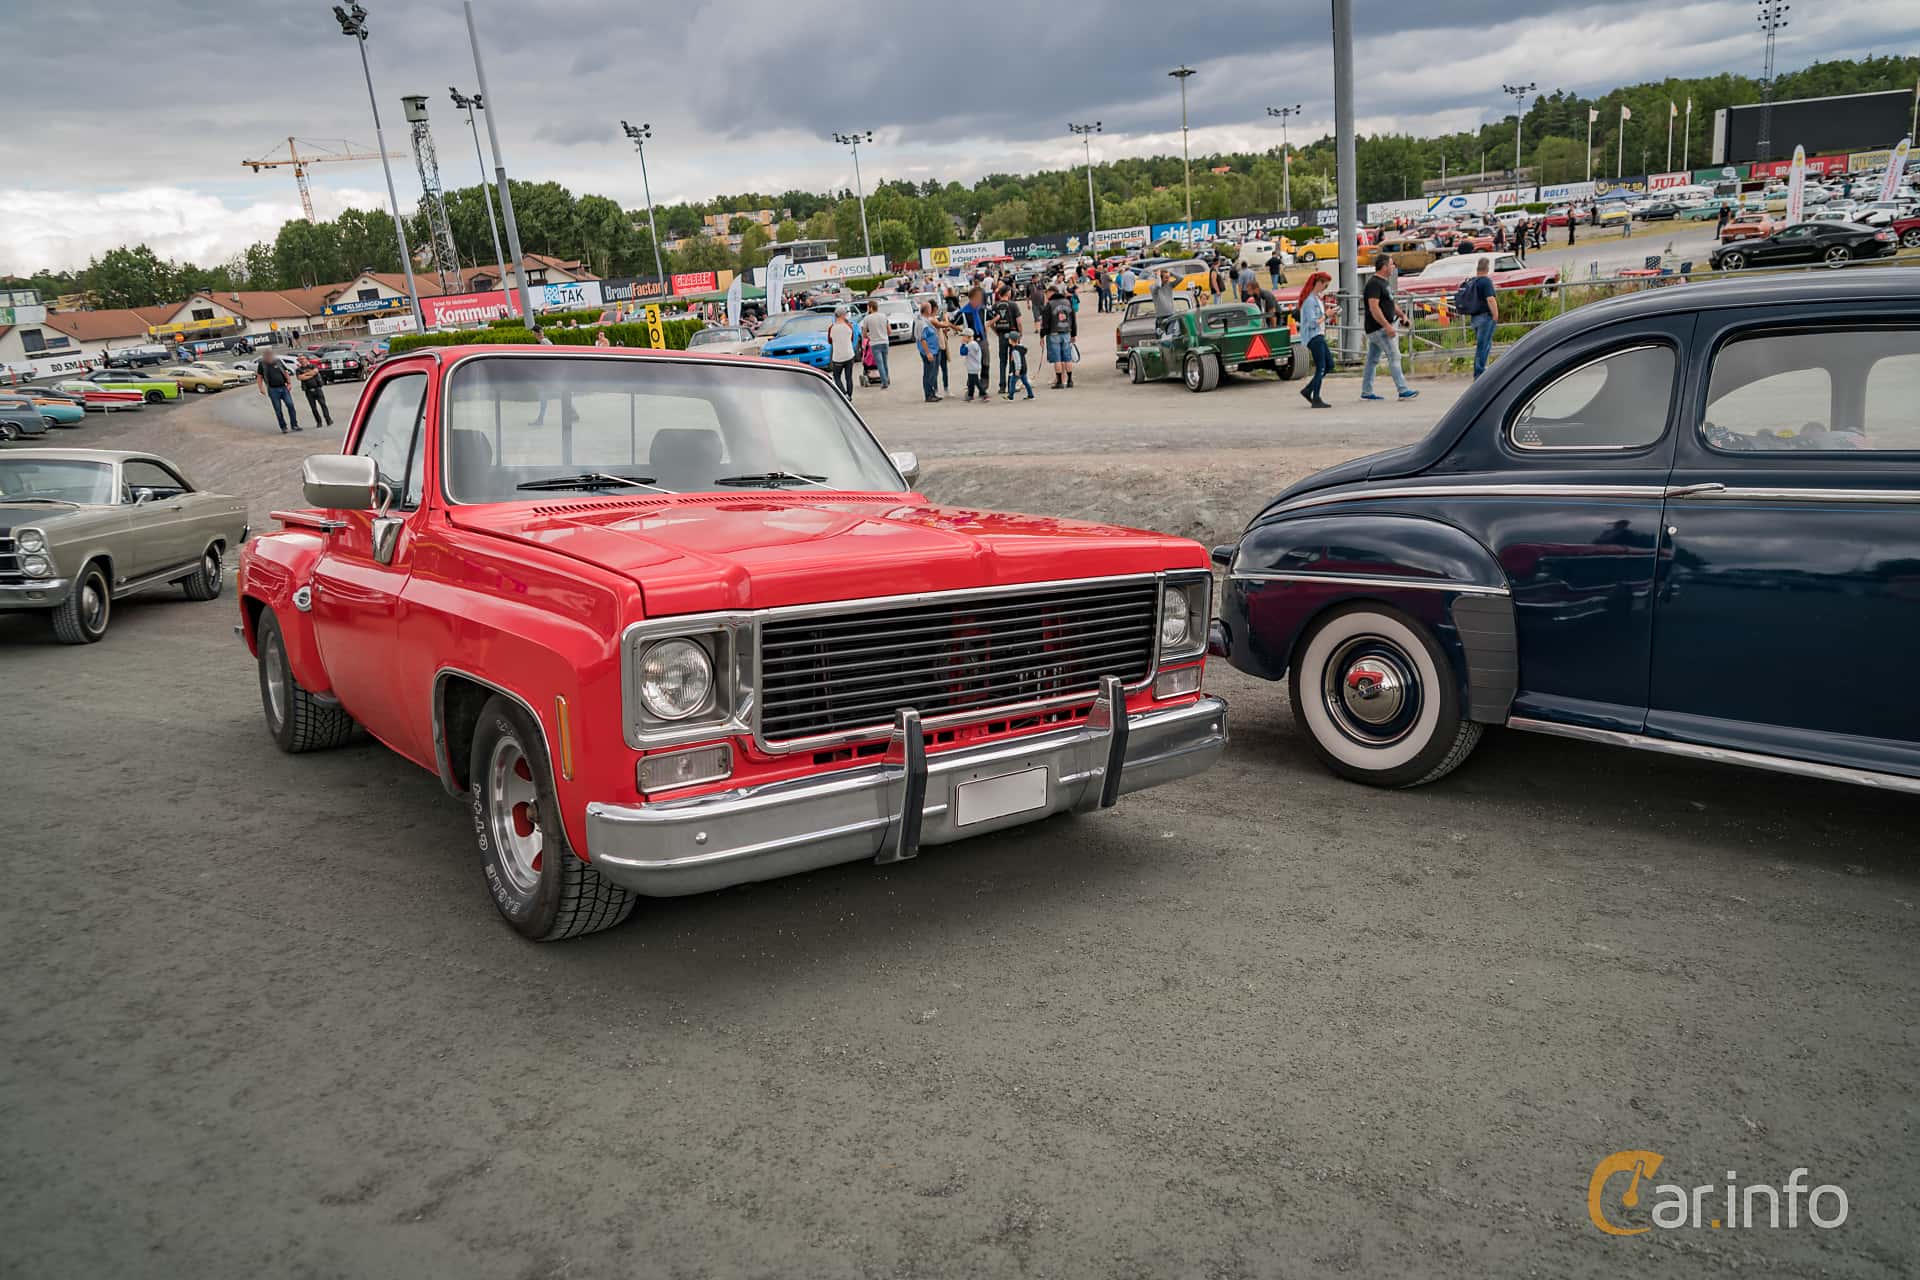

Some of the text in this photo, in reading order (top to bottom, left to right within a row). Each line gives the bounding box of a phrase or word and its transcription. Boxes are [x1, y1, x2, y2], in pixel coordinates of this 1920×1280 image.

[1651, 176, 1687, 190] JULA
[1096, 229, 1145, 242] EHANDER
[1160, 223, 1209, 240] ahlsell
[676, 272, 712, 287] GRABBER
[560, 288, 585, 304] TAK
[605, 281, 669, 301] BrandFactory
